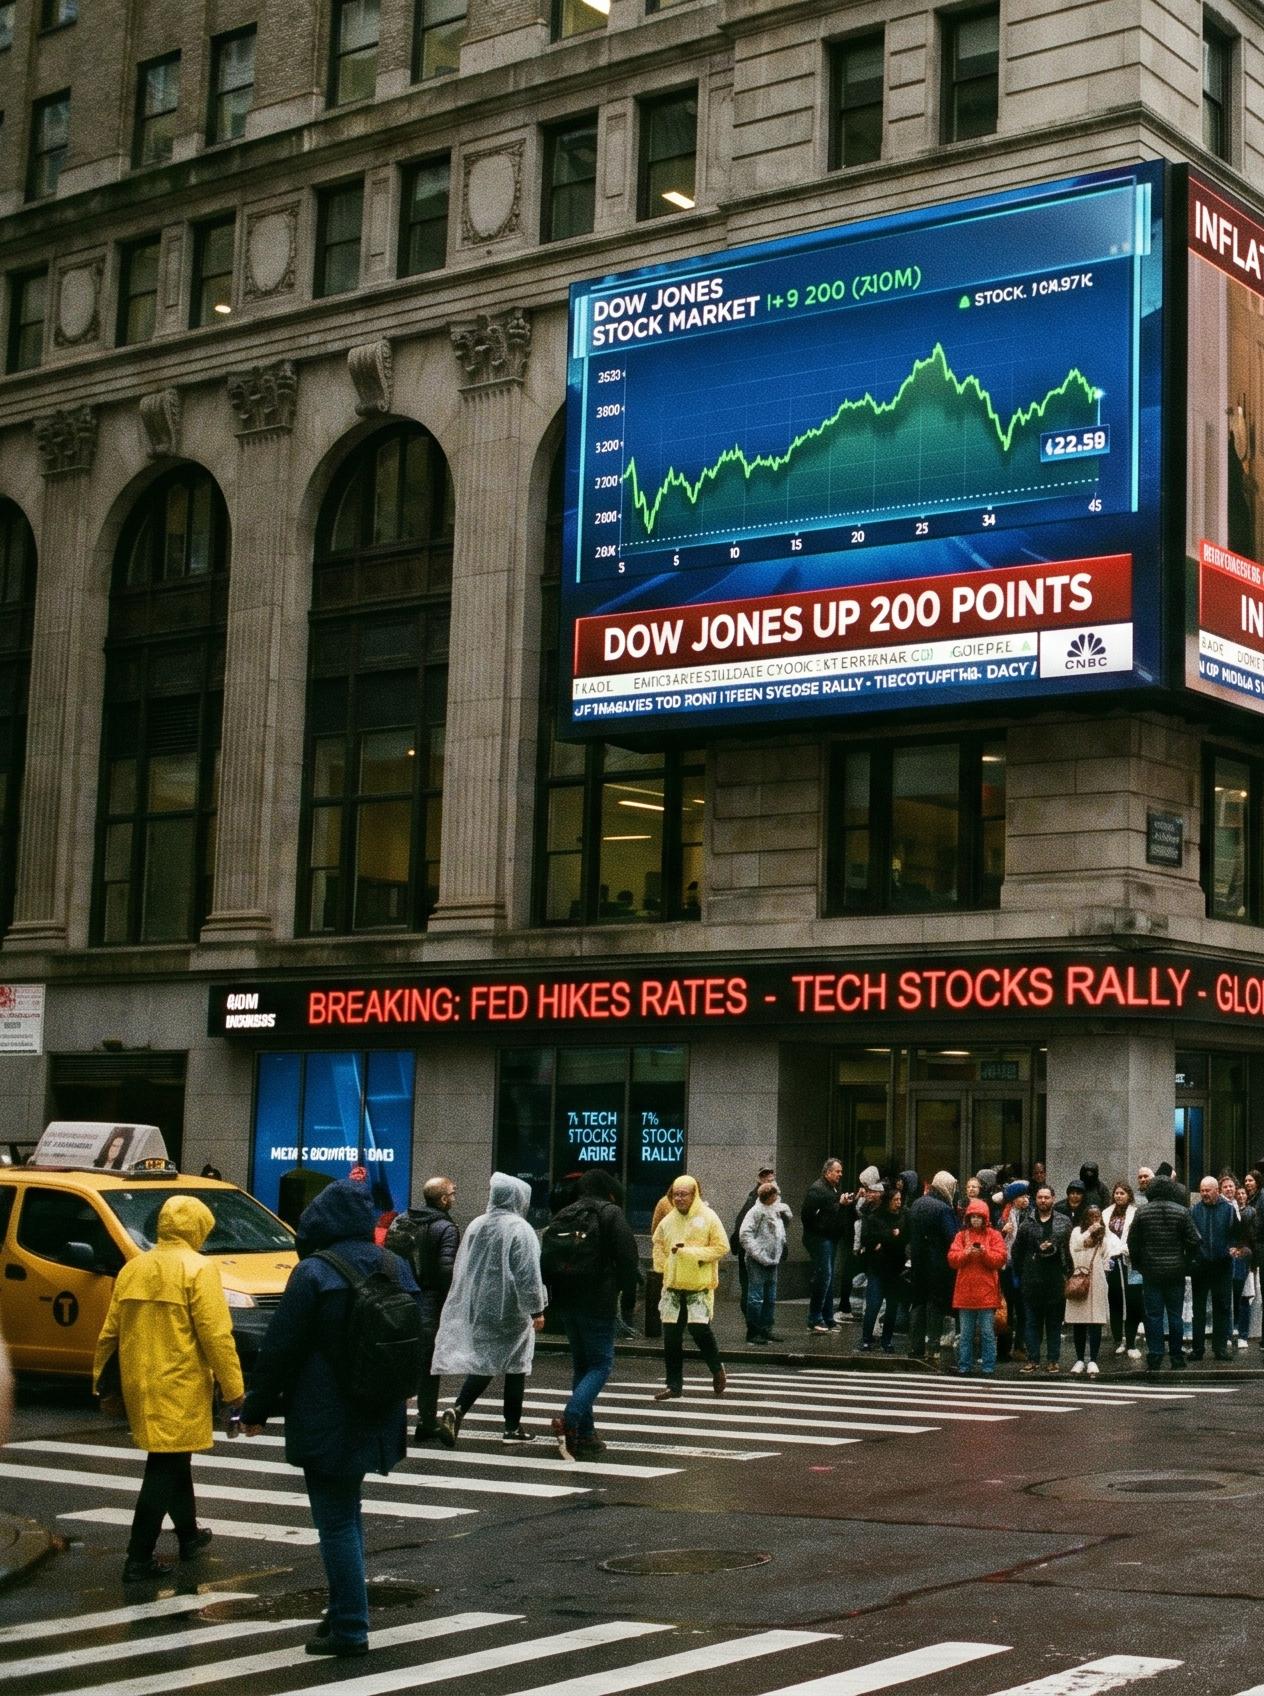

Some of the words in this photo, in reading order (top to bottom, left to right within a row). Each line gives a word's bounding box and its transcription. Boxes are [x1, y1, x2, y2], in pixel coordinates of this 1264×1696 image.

[594, 292, 647, 322] DOW
[651, 278, 723, 310] JONES
[805, 281, 845, 305] 200
[592, 314, 662, 346] STOCK
[669, 296, 760, 332] MARKET
[674, 555, 680, 566] 5
[730, 547, 740, 558] 10
[790, 538, 802, 550] 15
[851, 531, 865, 543] 20
[915, 523, 929, 535] 25
[982, 514, 996, 526] 34
[604, 620, 684, 662] DOW
[691, 606, 802, 652] JONES
[814, 600, 860, 638] UP
[870, 590, 940, 632] 200
[952, 572, 1092, 624] POINTS
[1065, 657, 1107, 670] CNBC
[822, 677, 864, 694] RALLY
[308, 988, 460, 1024] BREAKING:
[470, 985, 528, 1022] FED
[538, 982, 631, 1019] HIKES
[640, 977, 748, 1017] RATES
[792, 973, 886, 1012] TECH
[898, 966, 1054, 1010] STOCKS
[1066, 966, 1190, 1007] RALLY
[582, 1112, 616, 1126] TECH
[569, 1129, 616, 1143] STOCKS
[642, 1129, 684, 1143] STOCK
[642, 1147, 683, 1161] RALLY
